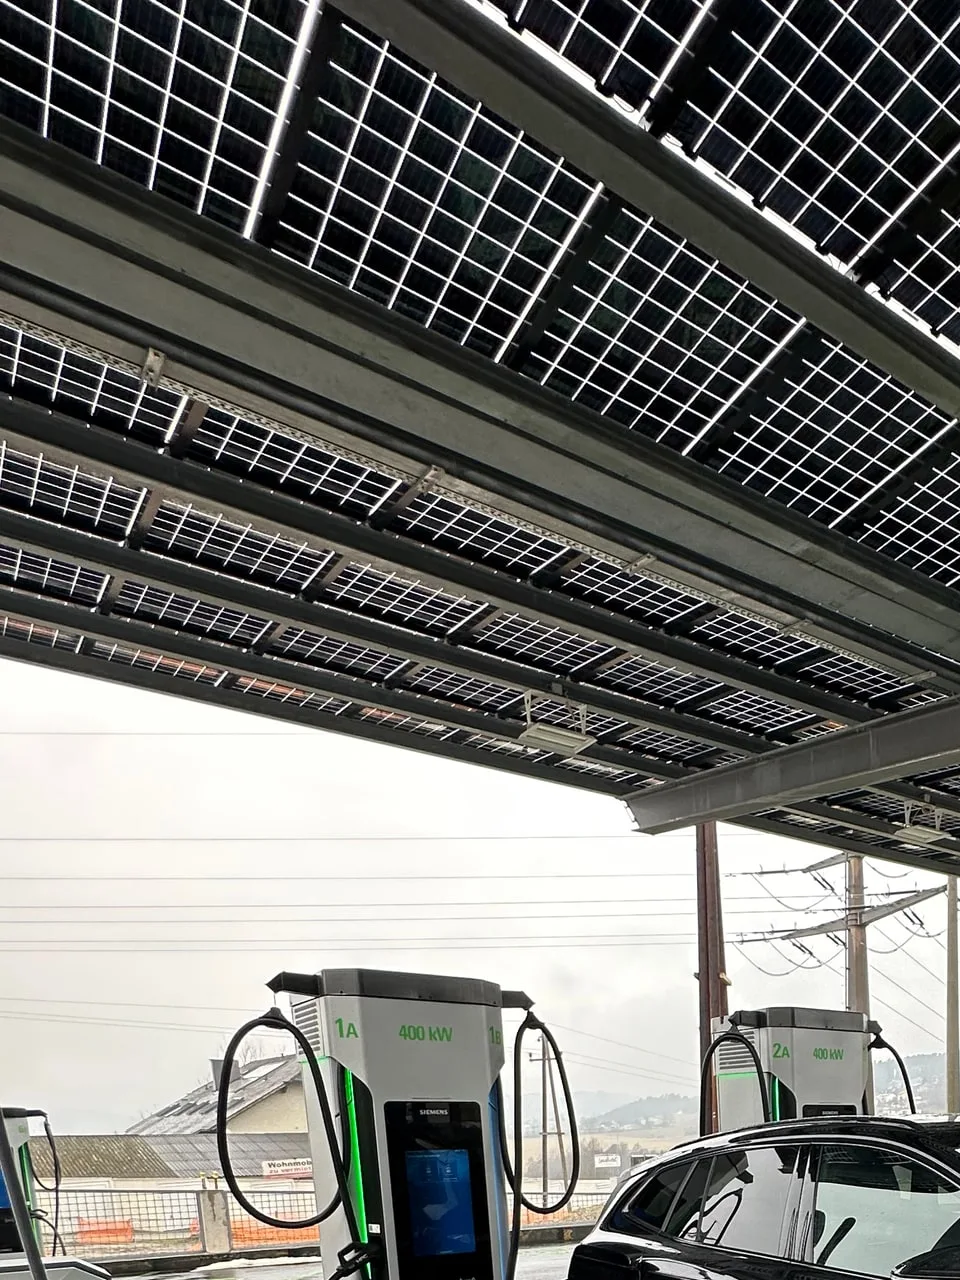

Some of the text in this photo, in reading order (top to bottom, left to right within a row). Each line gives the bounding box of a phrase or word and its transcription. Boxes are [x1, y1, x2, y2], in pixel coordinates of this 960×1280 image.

[335, 1018, 359, 1038] 1A
[399, 1025, 453, 1042] 400 kW
[772, 1043, 790, 1058] 2A
[813, 1047, 844, 1060] 400 kW
